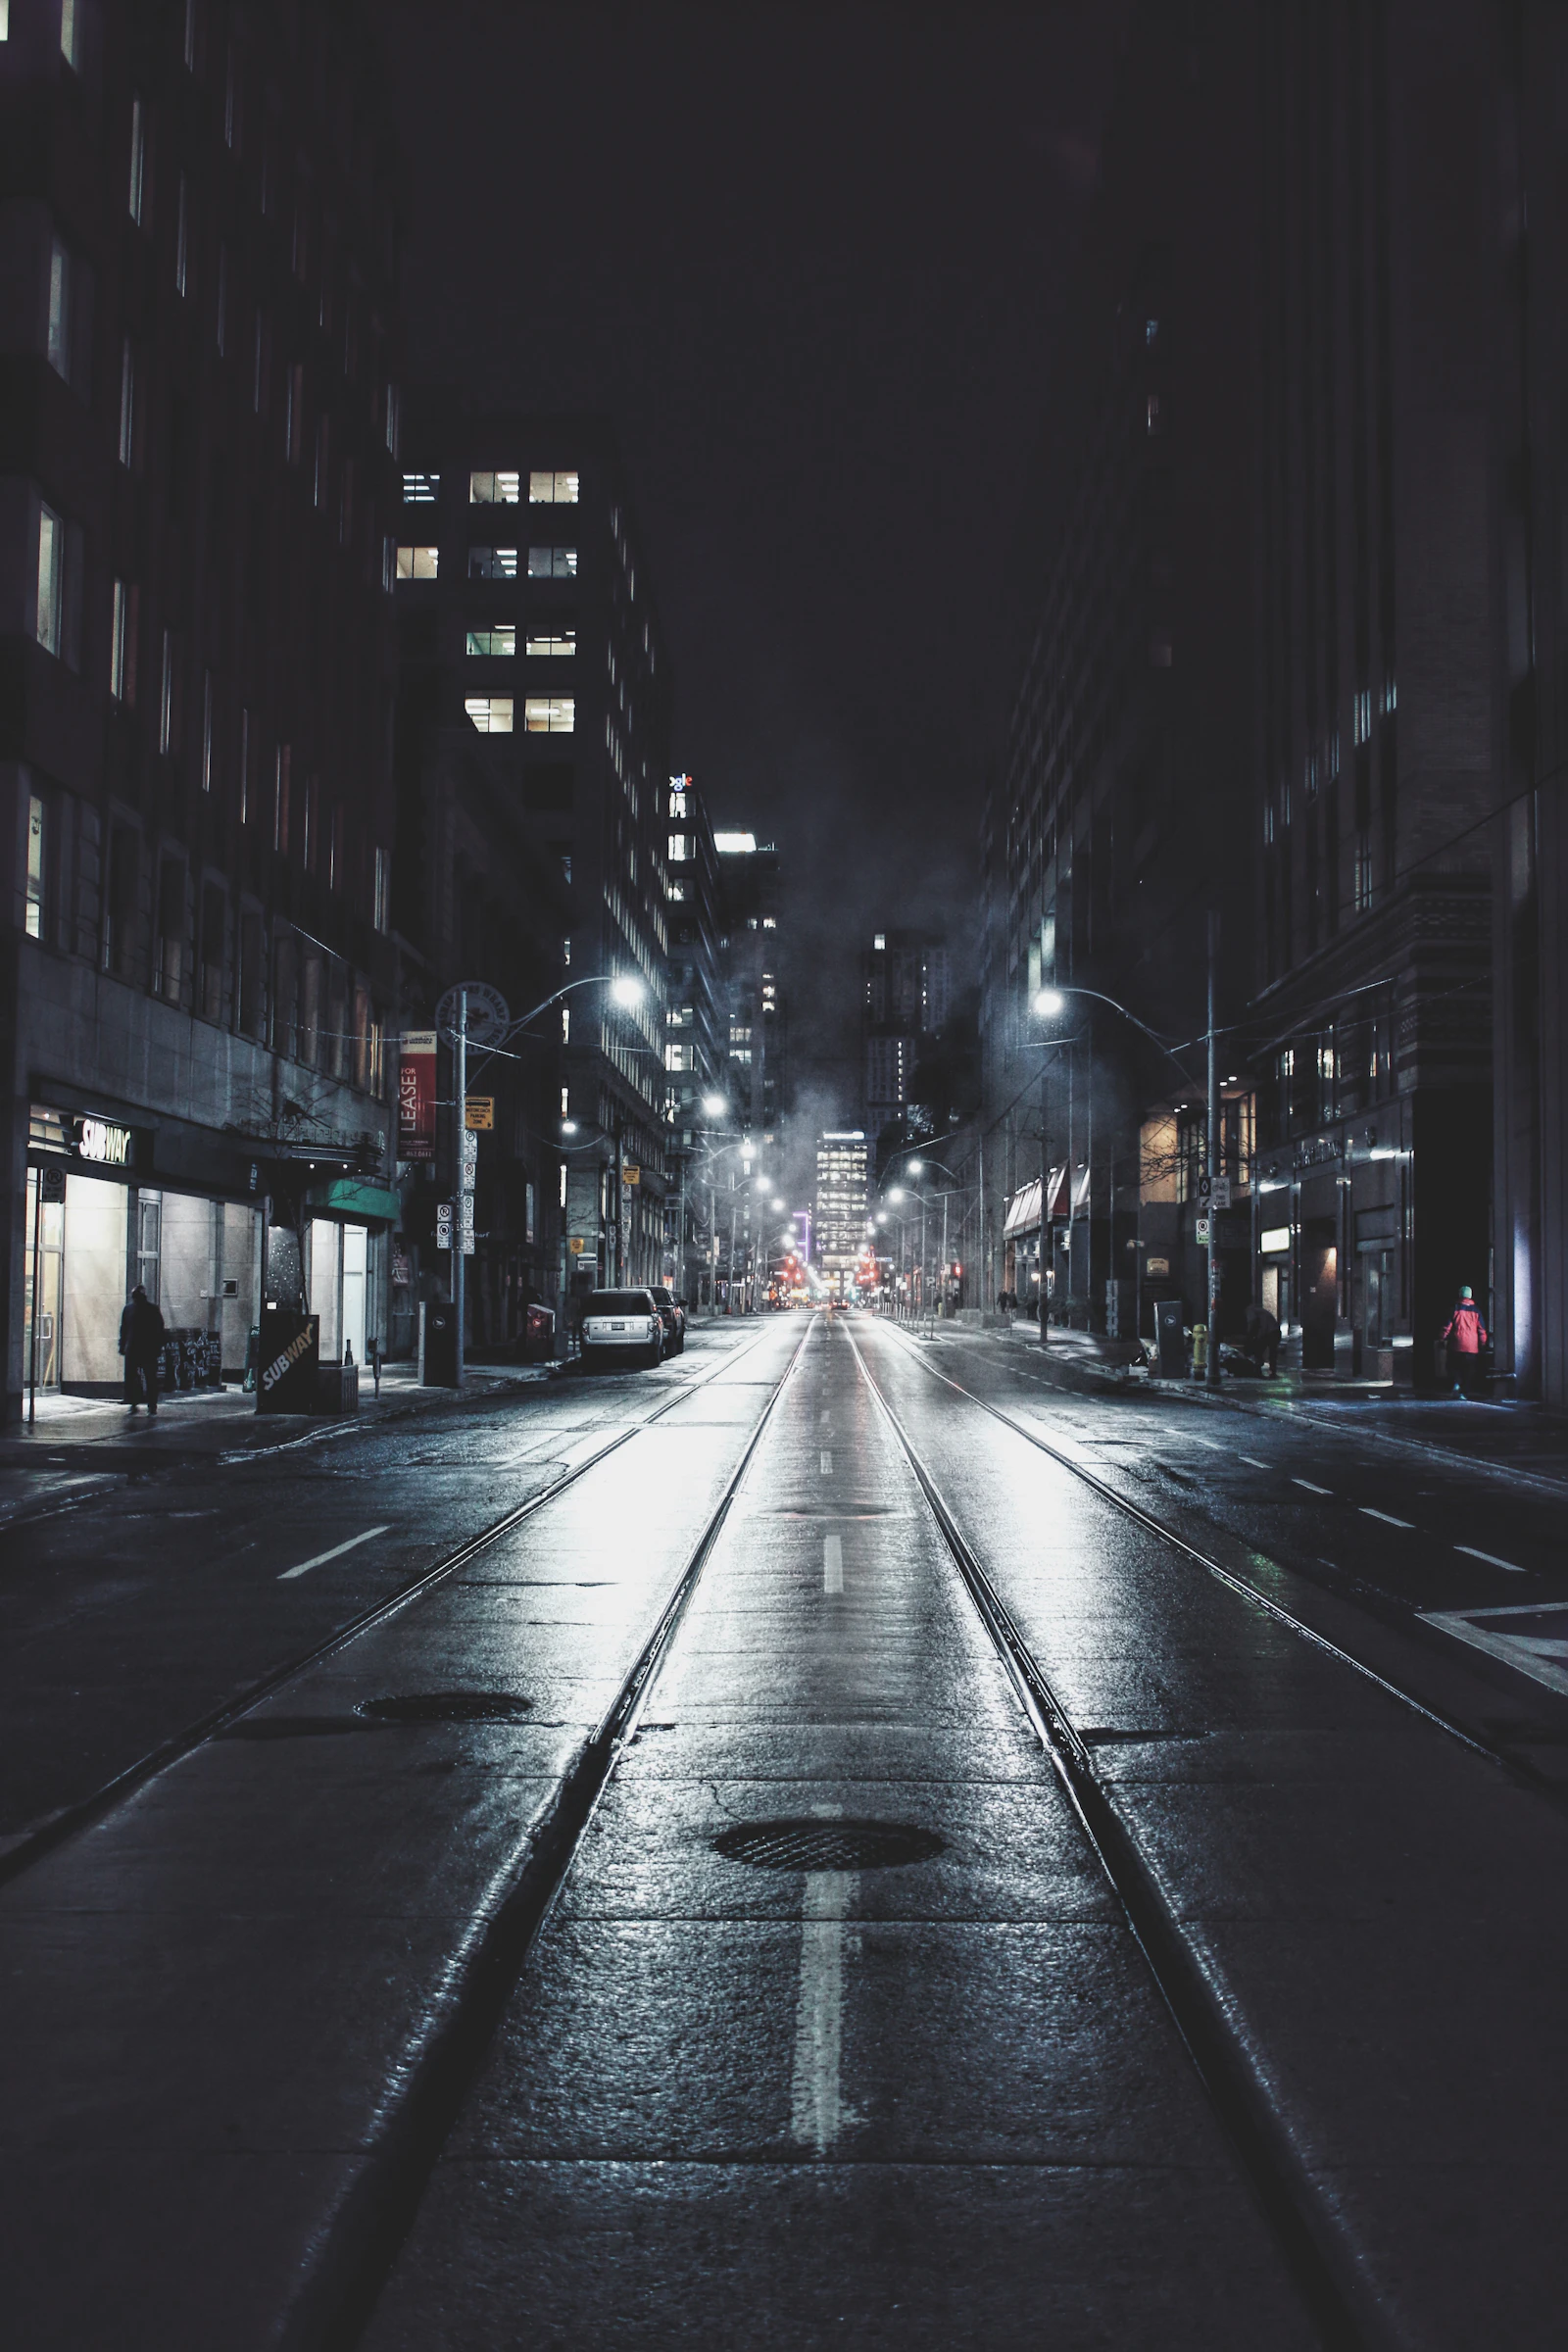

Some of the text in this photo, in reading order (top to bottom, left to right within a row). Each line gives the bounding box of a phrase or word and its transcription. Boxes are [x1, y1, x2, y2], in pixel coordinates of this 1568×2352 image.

[401, 1076, 416, 1131] LEASE
[78, 1119, 130, 1164] SUBWAY
[262, 1323, 314, 1391] SUBWAY
